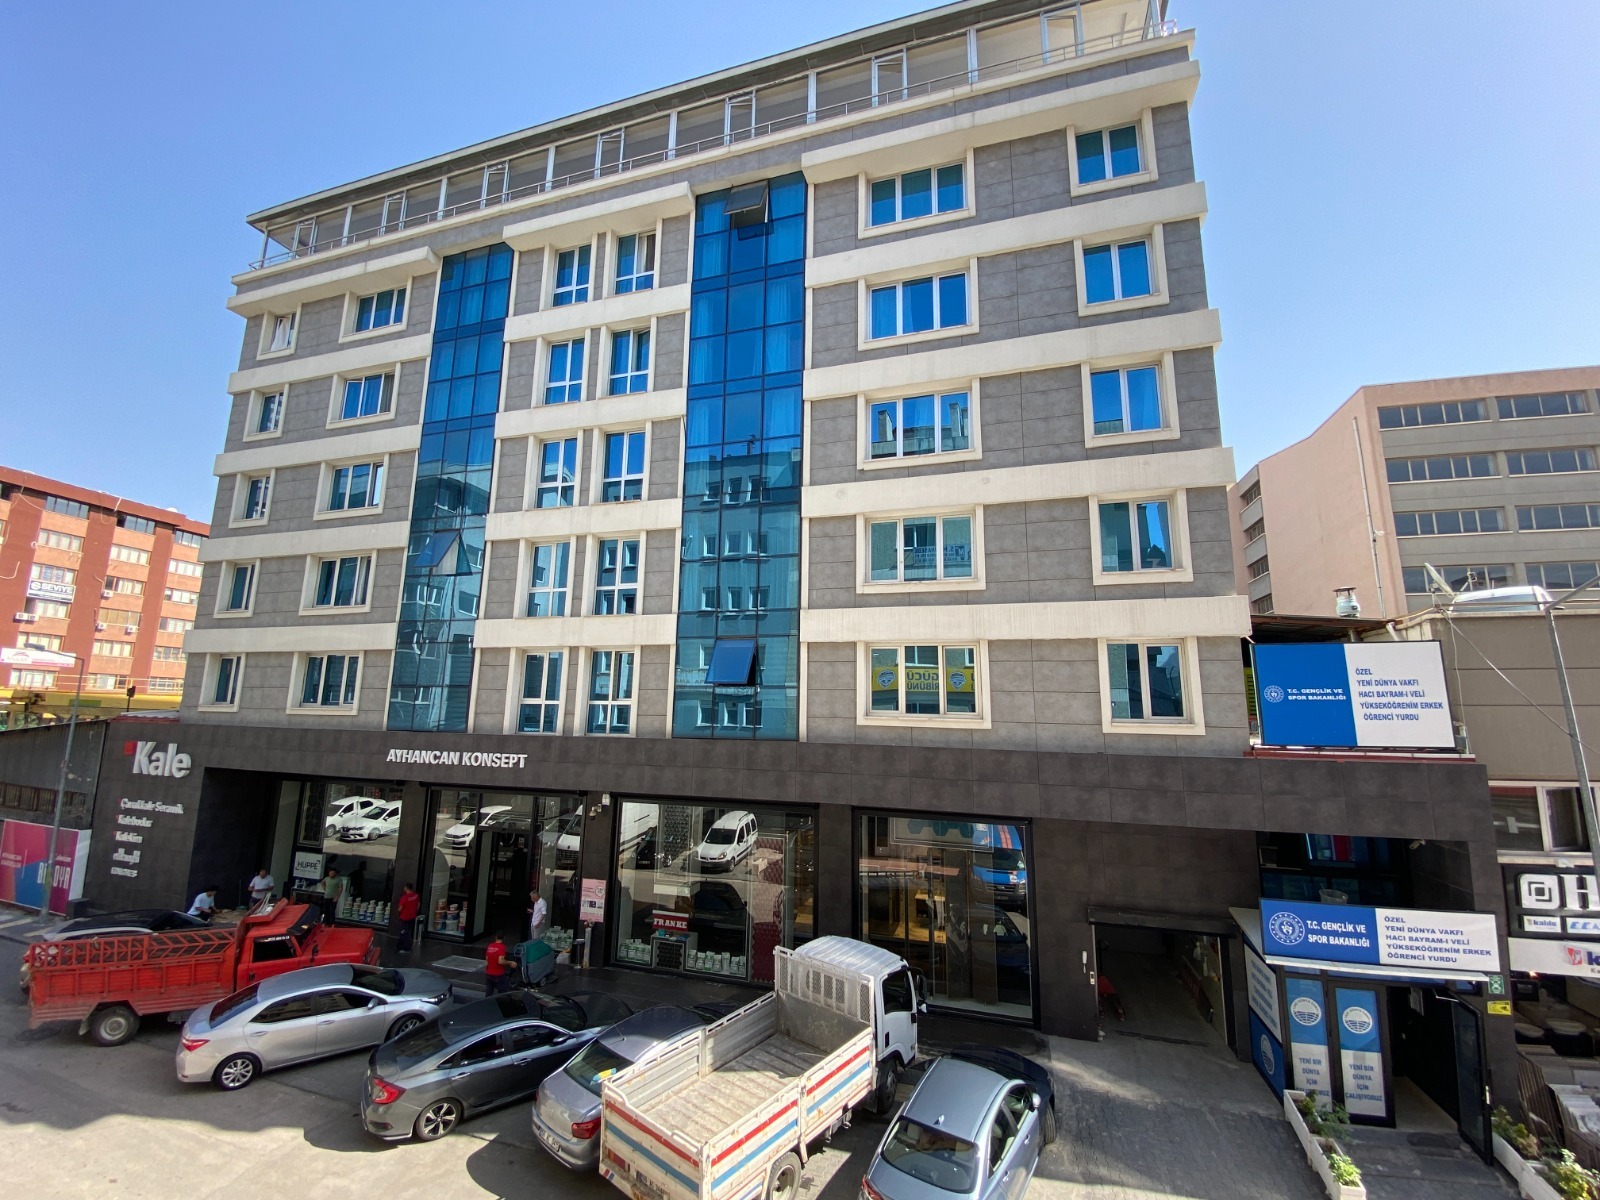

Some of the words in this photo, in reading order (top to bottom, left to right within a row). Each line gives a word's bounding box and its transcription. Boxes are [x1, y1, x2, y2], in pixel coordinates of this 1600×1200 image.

[1356, 668, 1373, 676] ÖZEL
[1410, 690, 1425, 698] VELİ
[1360, 701, 1418, 710] YÜKSEKÖĞRENİM
[1364, 712, 1394, 721] ÖĞRENCİ
[132, 740, 192, 778] Kale
[386, 749, 460, 765] AYHANCAN
[462, 752, 528, 768] KONSEPT
[654, 918, 687, 928] FRANKE
[1384, 916, 1406, 924] ÖZEL
[1306, 920, 1320, 930] T.C.
[1322, 922, 1354, 934] GENÇLİK
[1356, 924, 1366, 933] VE
[1408, 926, 1436, 934] DÜNYA
[1438, 928, 1464, 936] VAKFI
[1308, 934, 1328, 944] SPOR
[1330, 936, 1370, 948] BAKANLIĞI
[1386, 934, 1406, 942] HACI
[1408, 936, 1448, 944] BAYRAM-I
[1450, 938, 1470, 946] VELİ
[1386, 944, 1460, 954] YÜKSEKÖĞRENİM
[1462, 948, 1492, 956] ERKEK
[1388, 952, 1425, 960] ÖĞRENCİ
[1302, 1067, 1320, 1075] DÜNYA
[1352, 1073, 1372, 1081] DÜNYA
